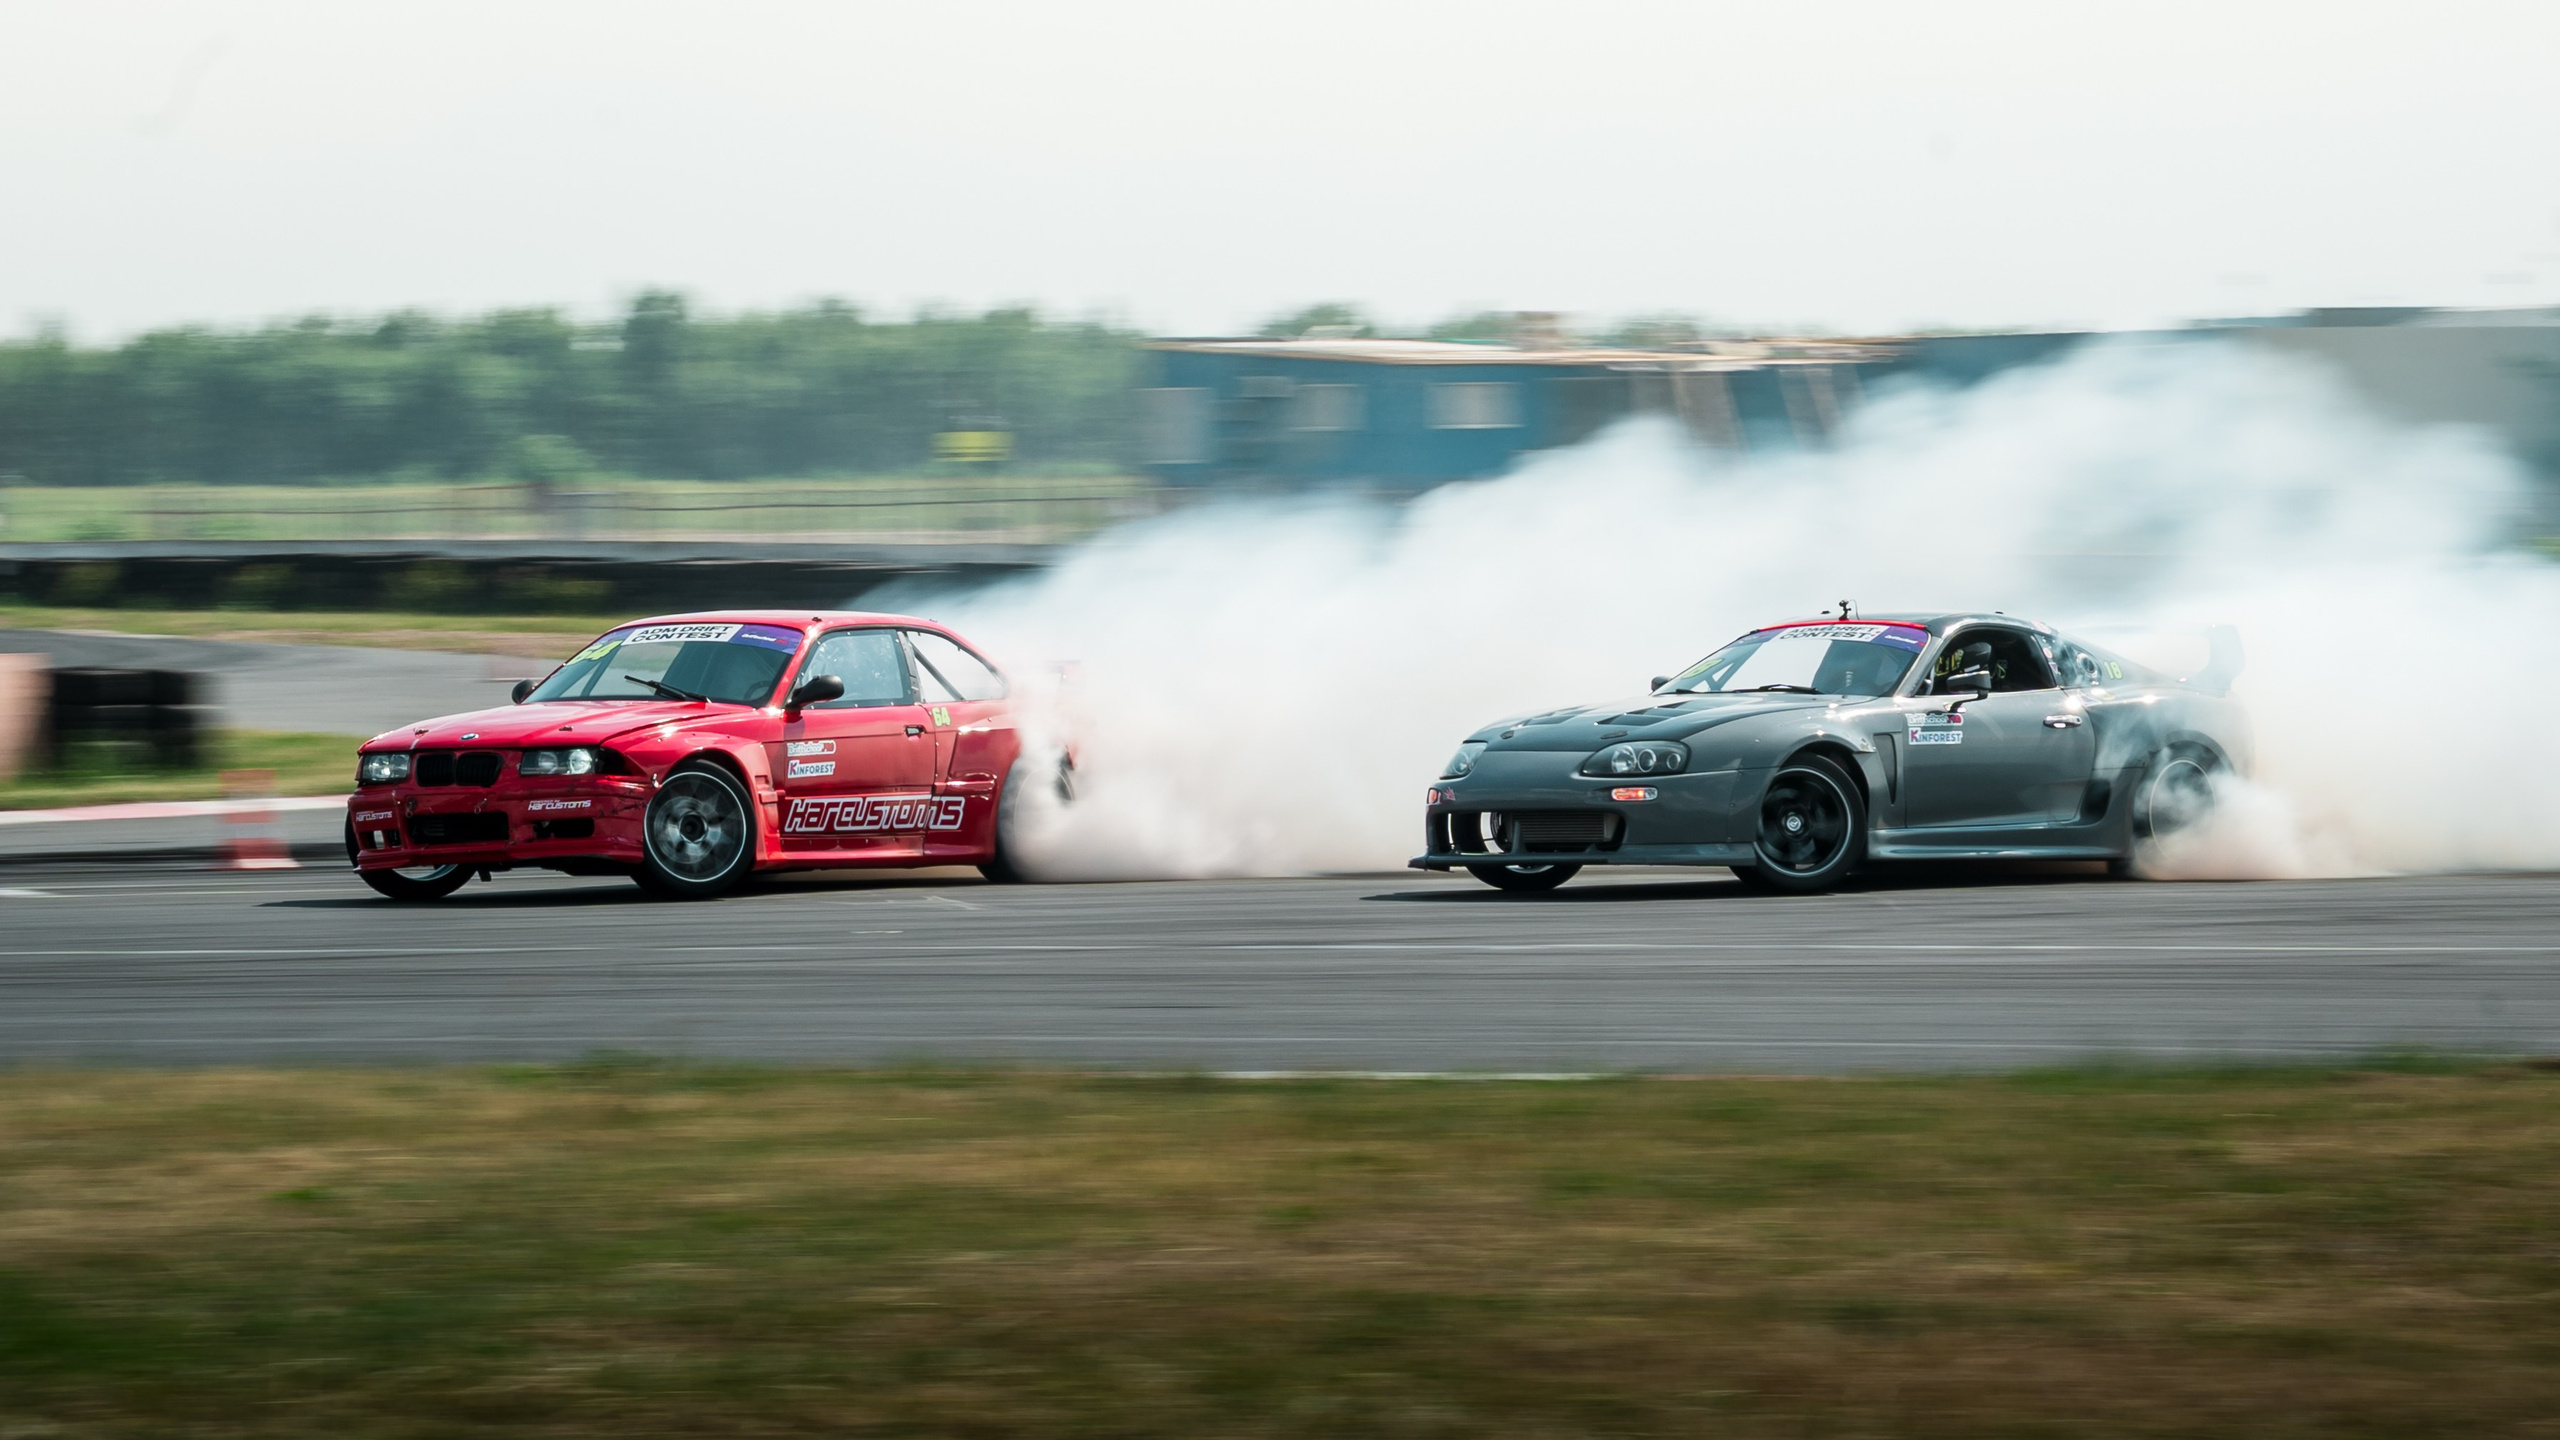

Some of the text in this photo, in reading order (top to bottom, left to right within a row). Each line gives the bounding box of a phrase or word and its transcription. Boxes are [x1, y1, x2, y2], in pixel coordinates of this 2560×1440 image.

[631, 632, 727, 643] CONTEST
[637, 627, 679, 636] ADM
[1780, 631, 1869, 640] CONTEST
[2103, 661, 2123, 679] 18
[932, 707, 951, 726] 64
[1910, 729, 1961, 743] KINFOREST
[789, 762, 834, 776] KINFOREST
